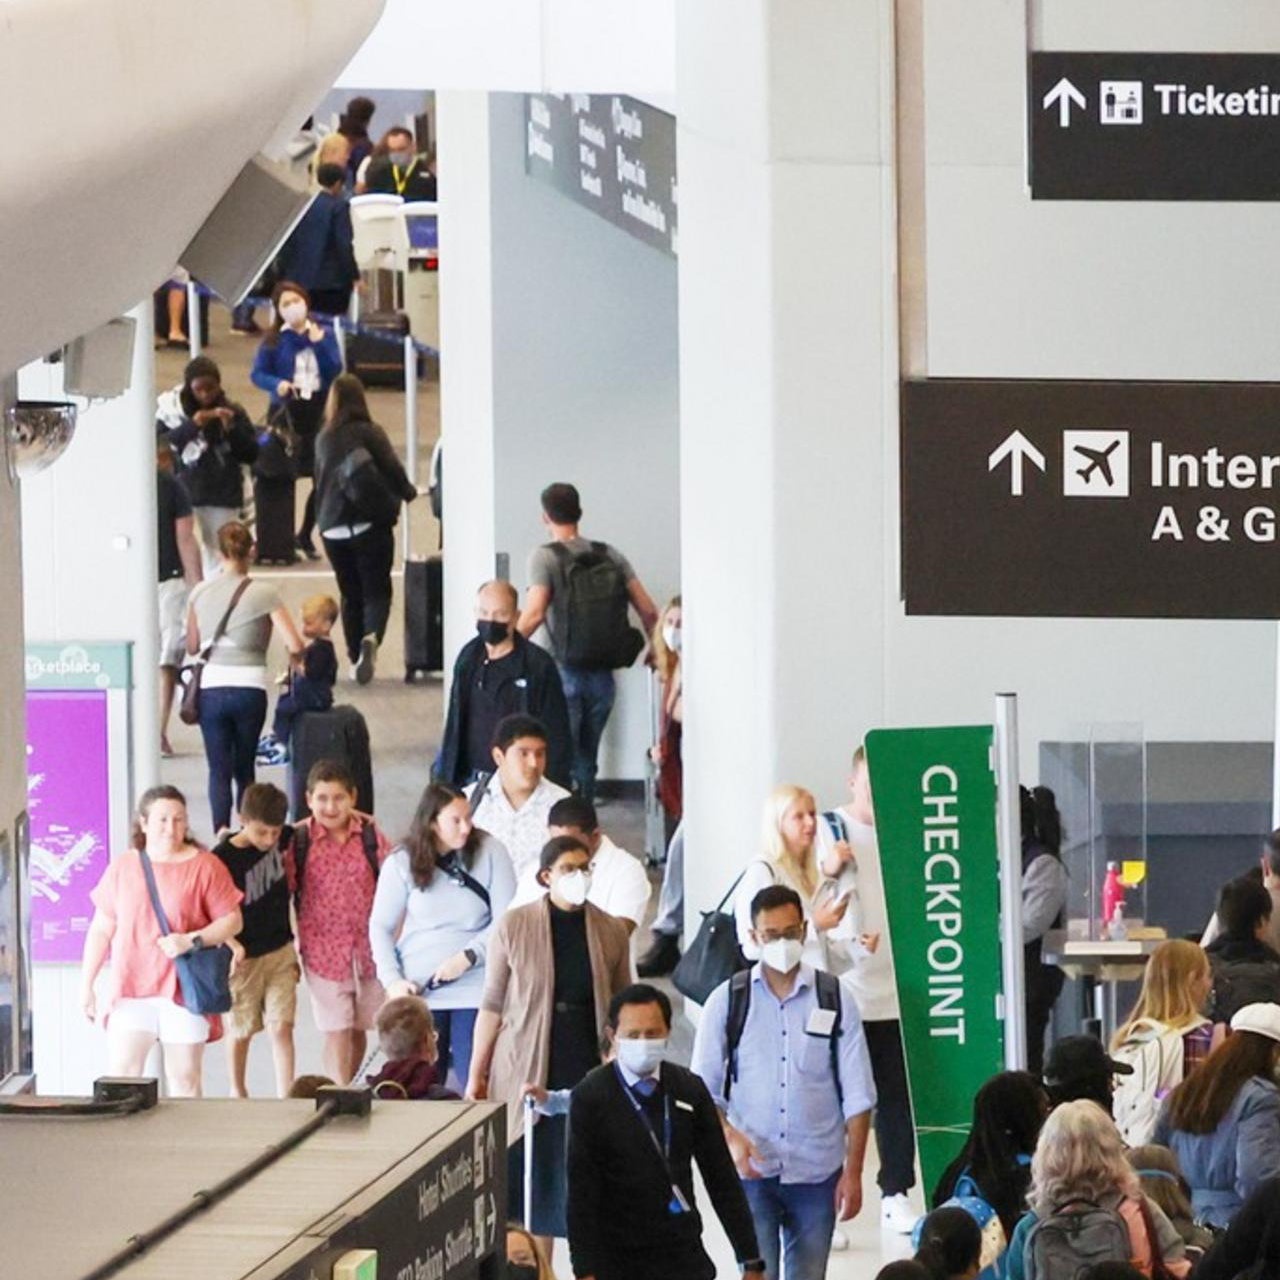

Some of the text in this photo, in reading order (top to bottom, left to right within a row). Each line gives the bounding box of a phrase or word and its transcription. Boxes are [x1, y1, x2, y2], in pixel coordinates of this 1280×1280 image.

[1151, 506, 1184, 541] A
[1196, 505, 1231, 542] &
[1243, 506, 1276, 542] G
[921, 764, 966, 1046] CHECKPOINT
